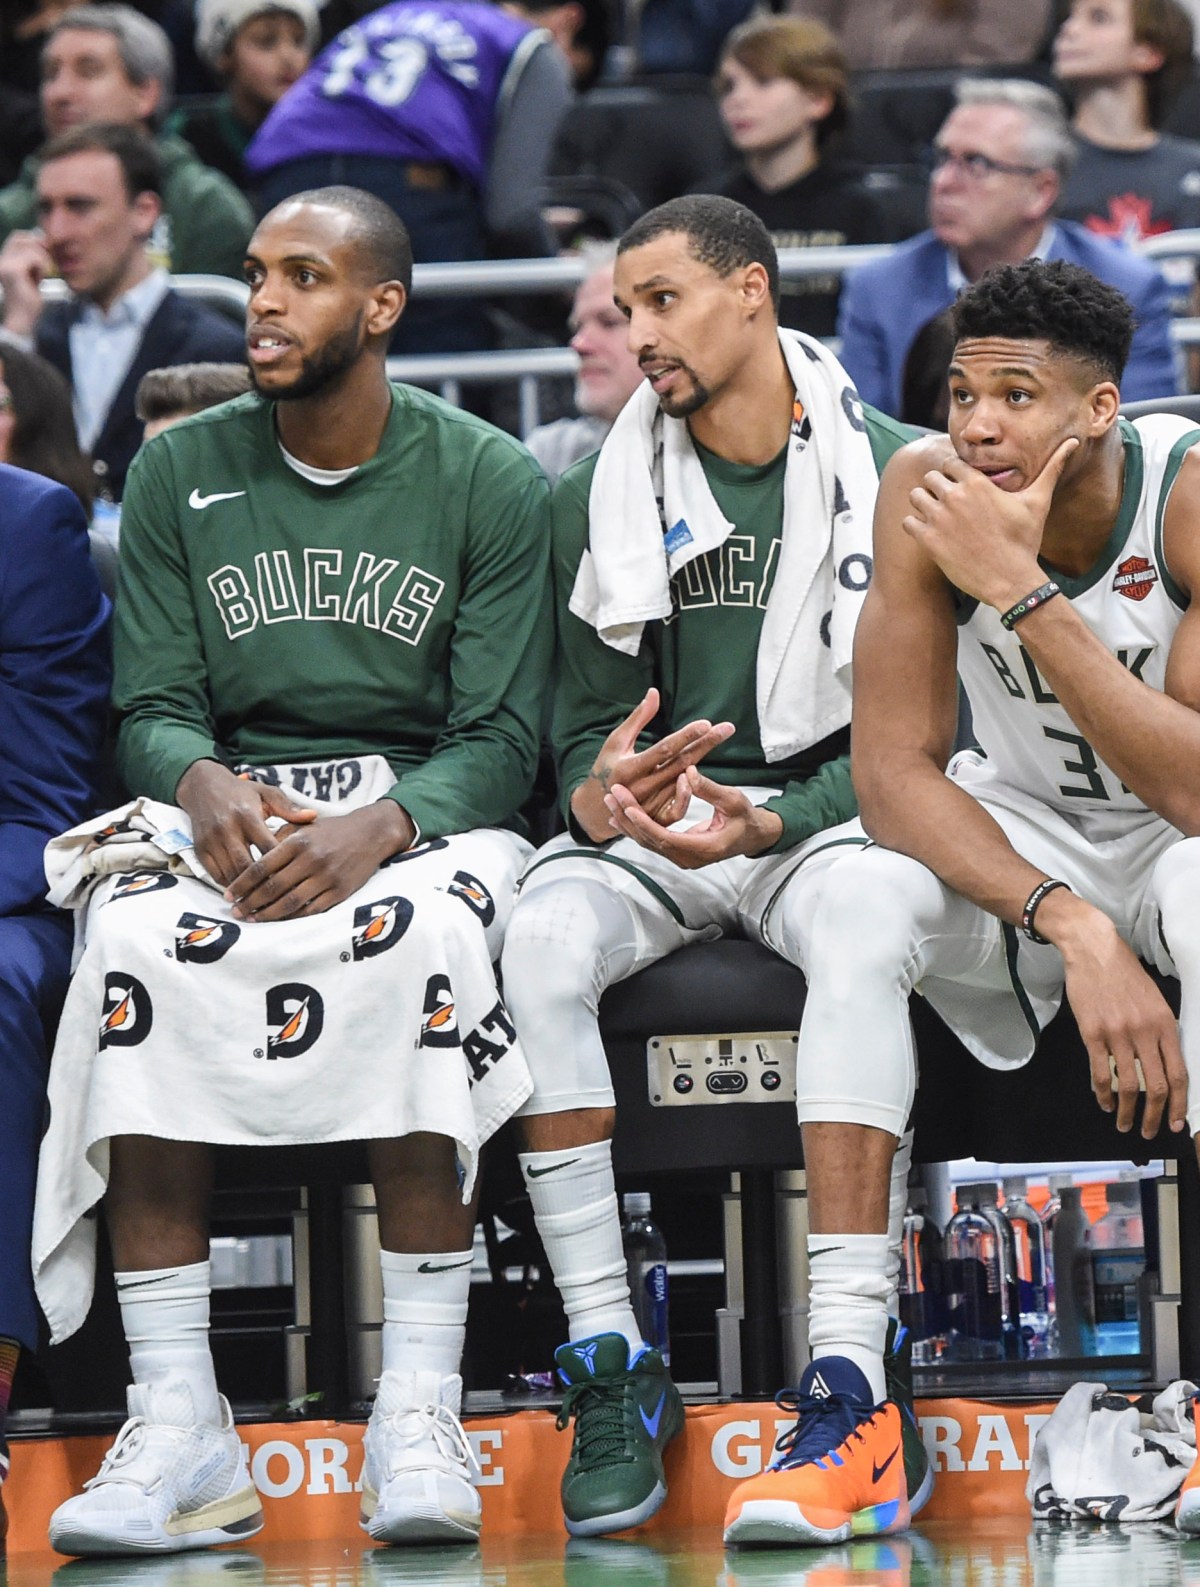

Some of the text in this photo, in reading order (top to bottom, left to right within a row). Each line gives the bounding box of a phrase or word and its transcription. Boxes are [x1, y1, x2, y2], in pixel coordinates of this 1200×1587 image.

[206, 548, 446, 647] BUCKS
[1026, 887, 1044, 911] Never
[175, 912, 241, 964] G
[352, 896, 415, 962] G
[265, 982, 325, 1061] G
[656, 1268, 666, 1302] water
